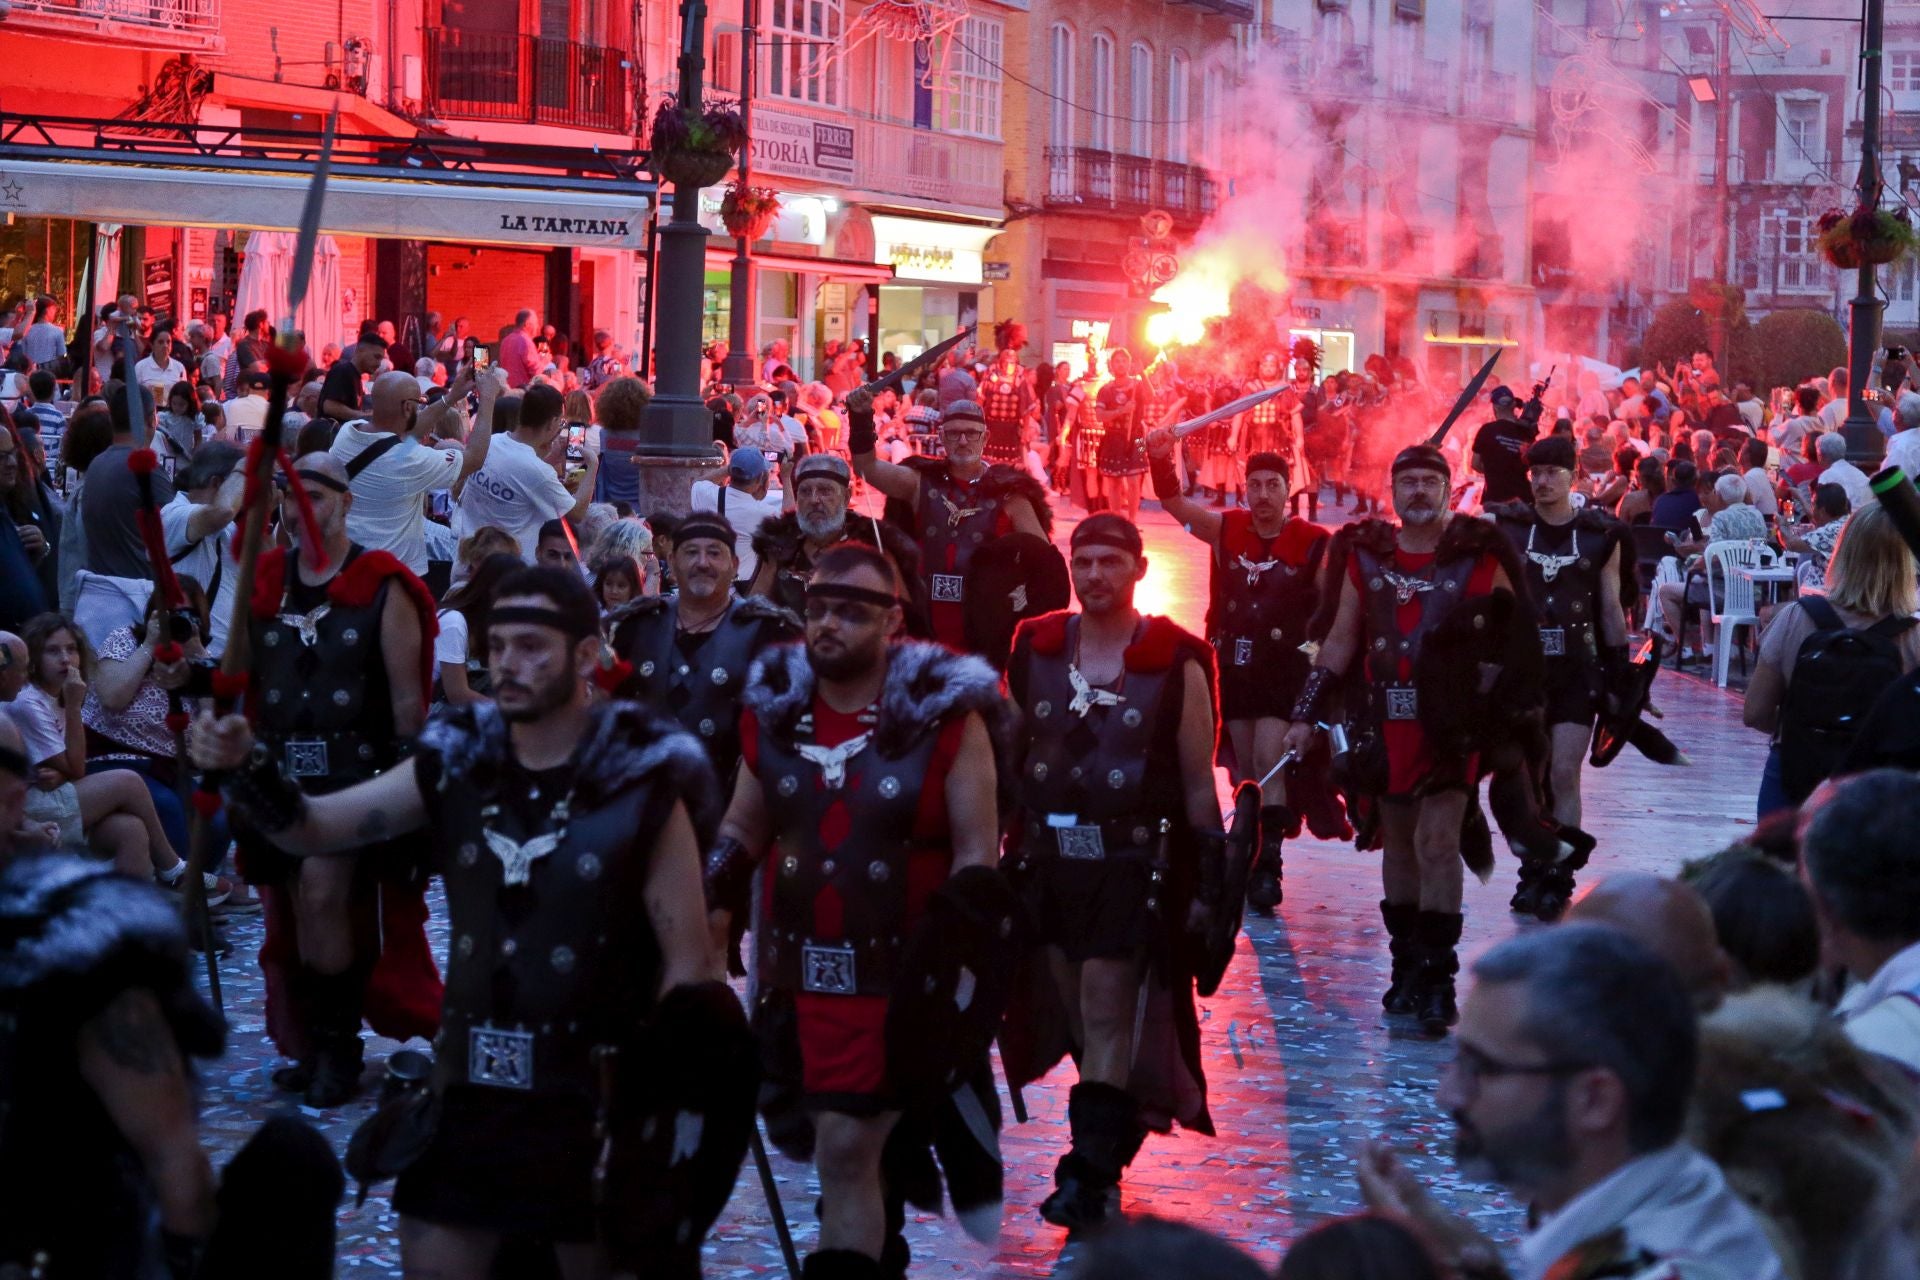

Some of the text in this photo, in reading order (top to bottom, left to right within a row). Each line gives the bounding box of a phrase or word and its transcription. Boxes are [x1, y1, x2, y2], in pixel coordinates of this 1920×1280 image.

[816, 125, 852, 148] FERRER
[500, 215, 629, 236] LA TARTANA
